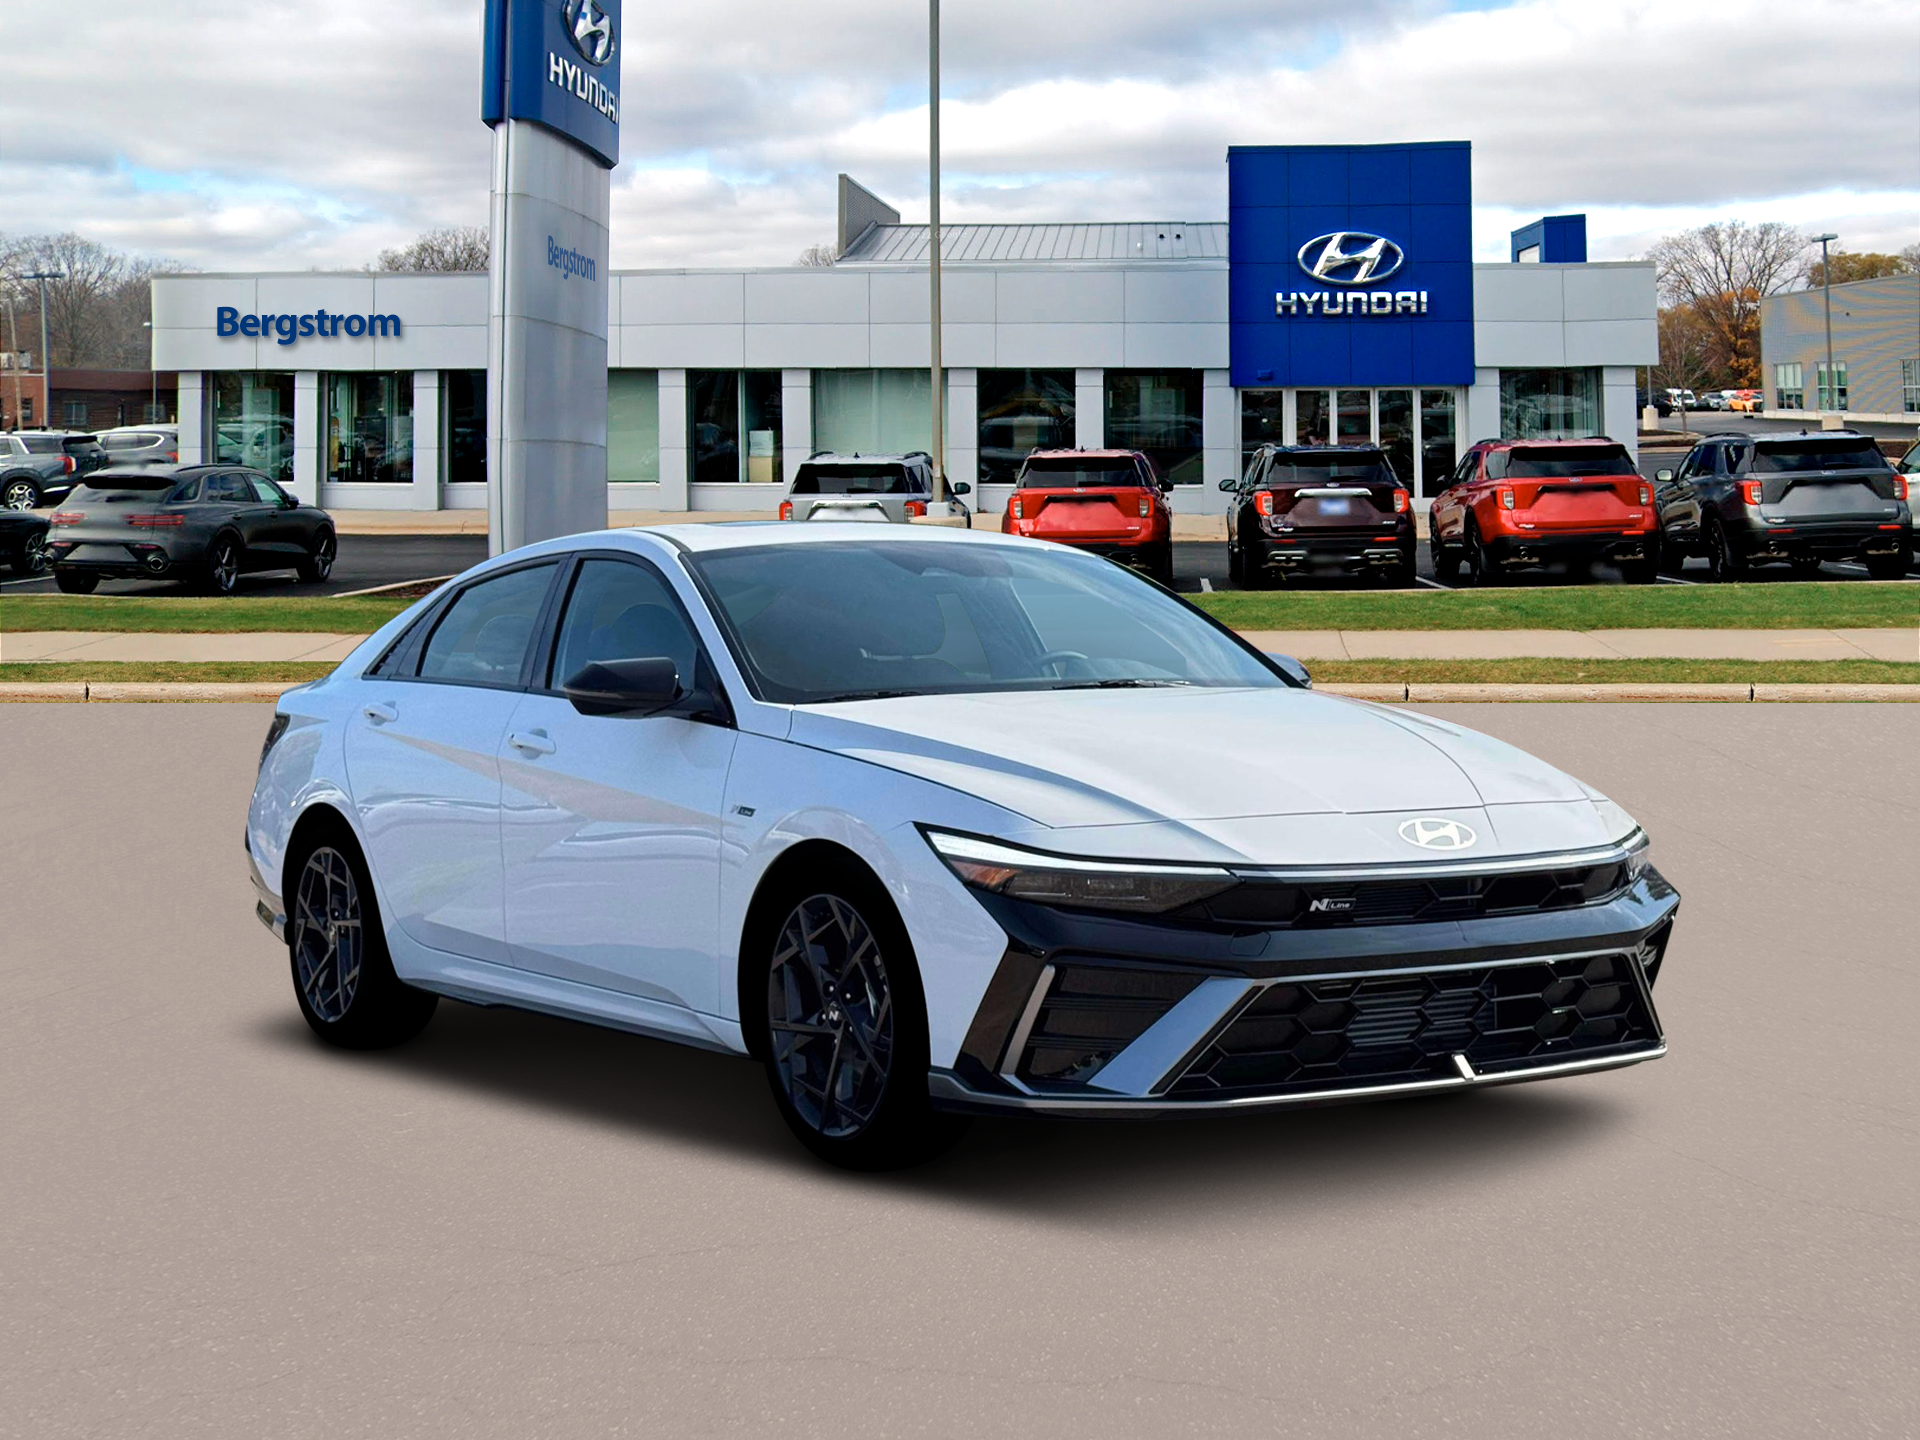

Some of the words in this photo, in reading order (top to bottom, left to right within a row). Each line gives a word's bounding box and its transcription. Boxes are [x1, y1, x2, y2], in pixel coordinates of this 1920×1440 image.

[548, 51, 619, 124] HYUNDAI
[547, 234, 596, 282] Bergstrom
[1275, 290, 1428, 315] HYUNDAI
[216, 306, 401, 346] Bergstrom
